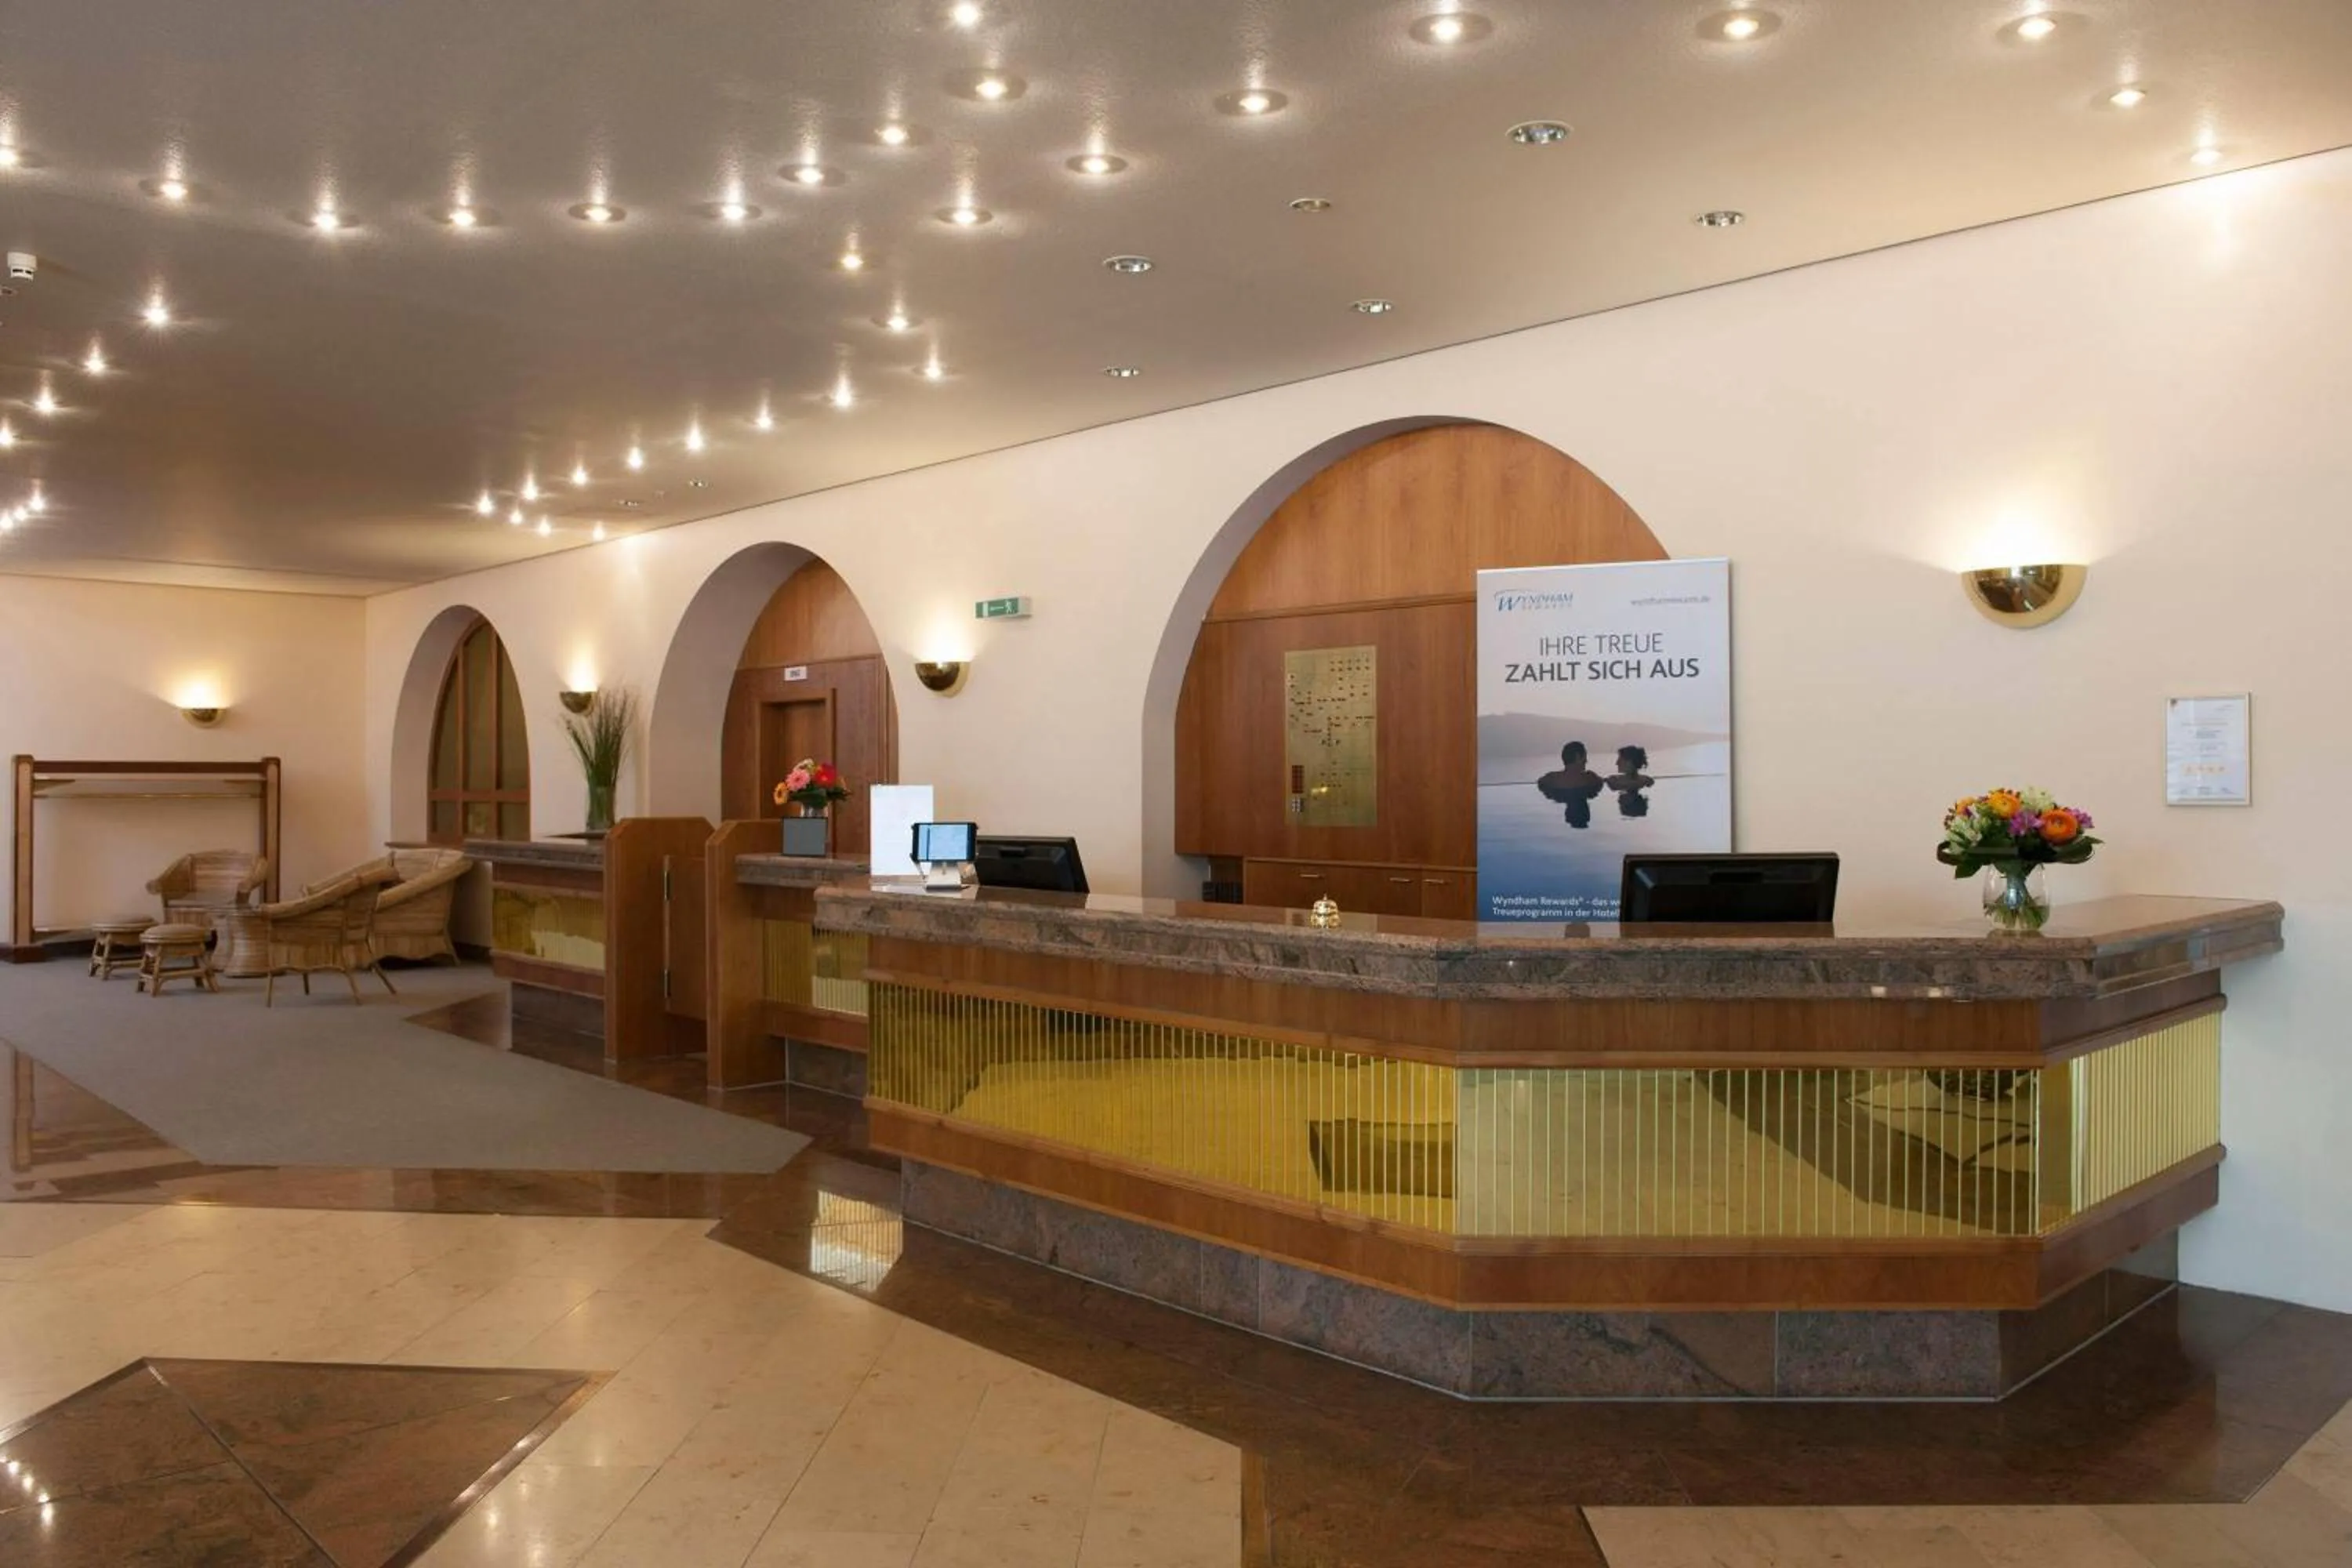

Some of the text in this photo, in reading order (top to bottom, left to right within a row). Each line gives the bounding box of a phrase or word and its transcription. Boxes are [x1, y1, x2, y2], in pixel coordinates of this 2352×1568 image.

[1539, 633, 1664, 656] IHRE TREUE
[1504, 657, 1700, 683] ZAHLT SICH AUS
[1492, 895, 1538, 907] Wyndham
[1492, 907, 1562, 918] Treueprogramm
[1564, 907, 1573, 916] in
[1575, 908, 1590, 916] der
